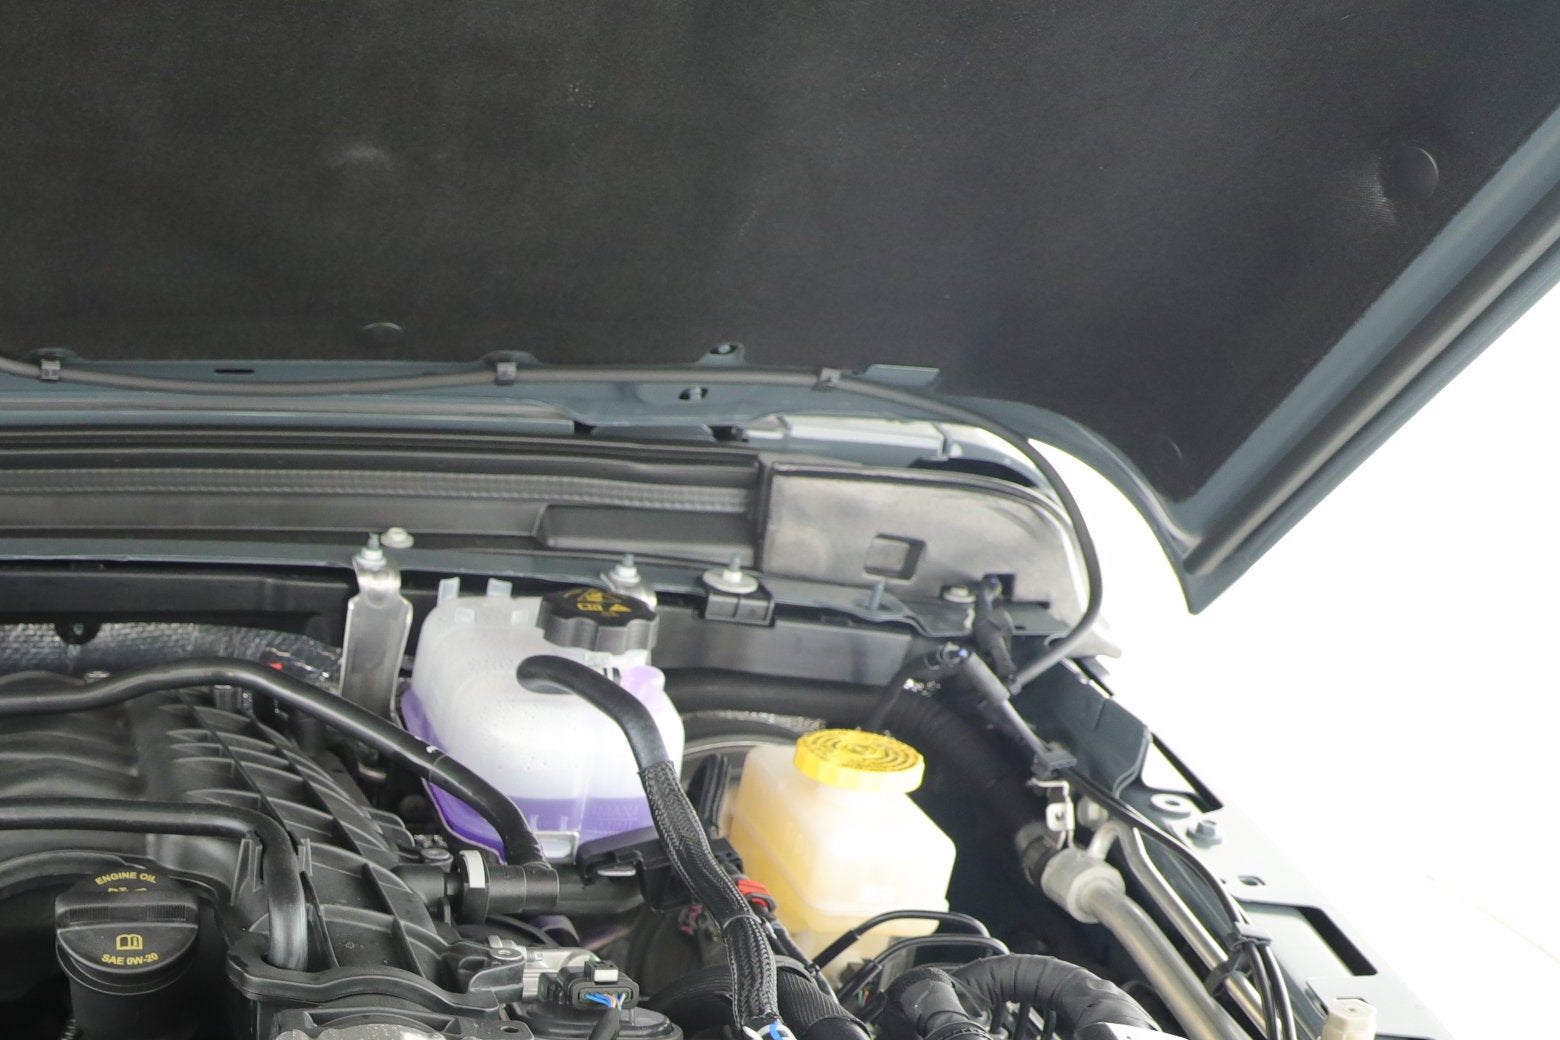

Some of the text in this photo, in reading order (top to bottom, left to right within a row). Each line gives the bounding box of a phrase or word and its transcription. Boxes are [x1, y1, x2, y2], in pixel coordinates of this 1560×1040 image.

[94, 871, 157, 885] ENGINE OIL
[101, 952, 159, 965] SAE 0W-20
